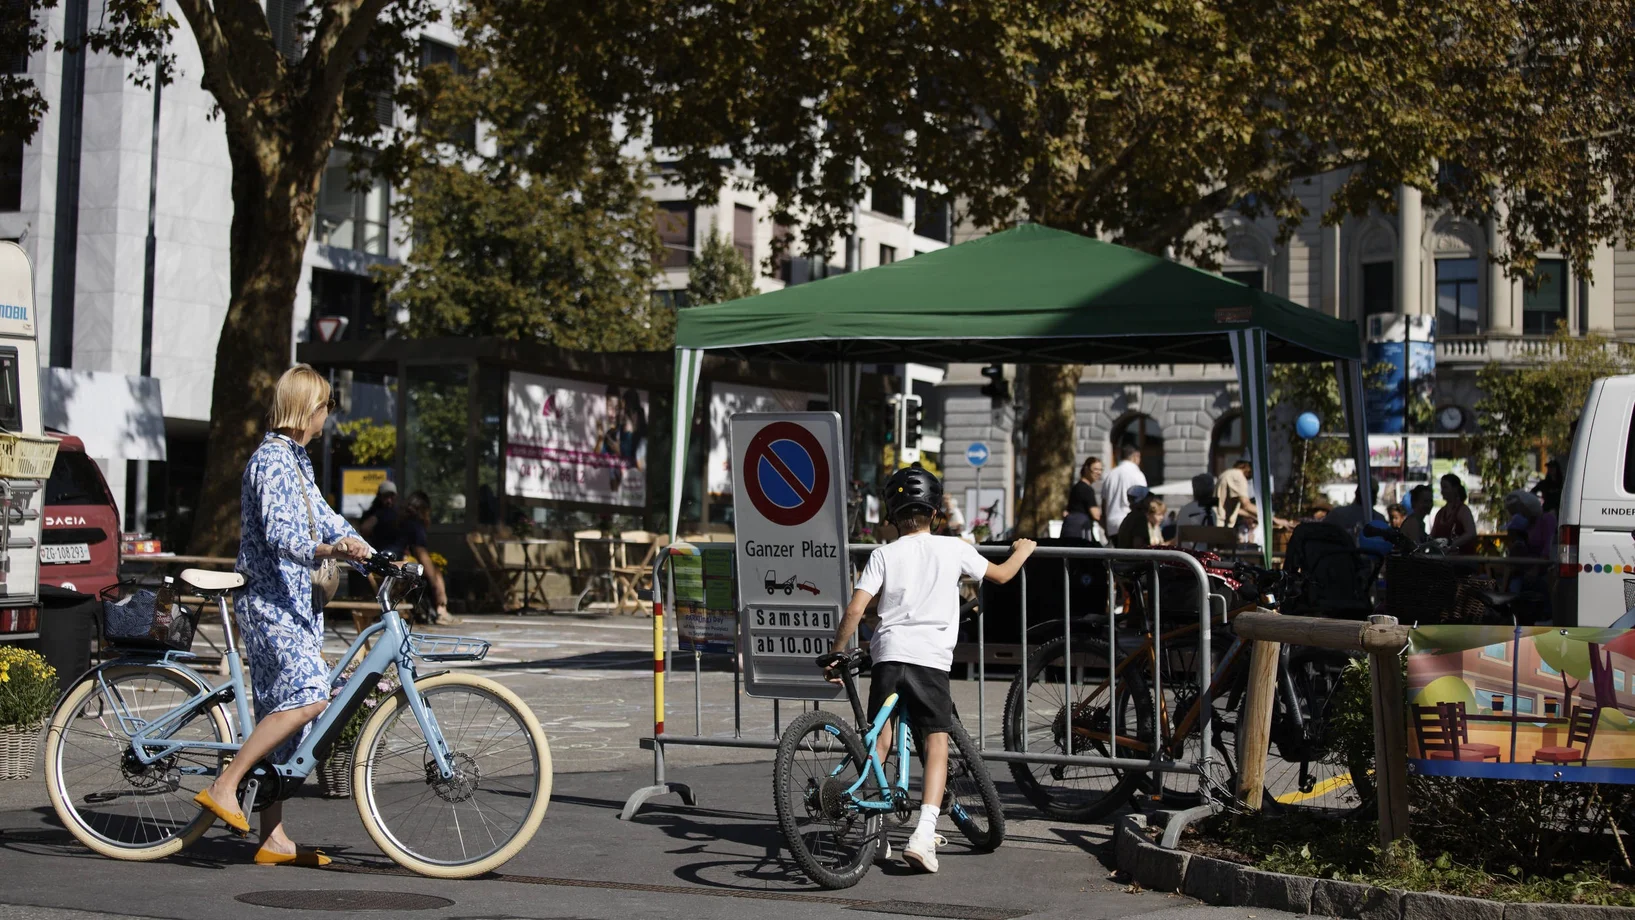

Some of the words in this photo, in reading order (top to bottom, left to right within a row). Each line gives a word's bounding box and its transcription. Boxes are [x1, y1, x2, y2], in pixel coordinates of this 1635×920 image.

[45, 516, 87, 526] DACIA
[745, 540, 795, 557] Ganzer
[801, 540, 837, 558] Platz
[756, 608, 831, 629] Samstag
[757, 636, 775, 653] ab
